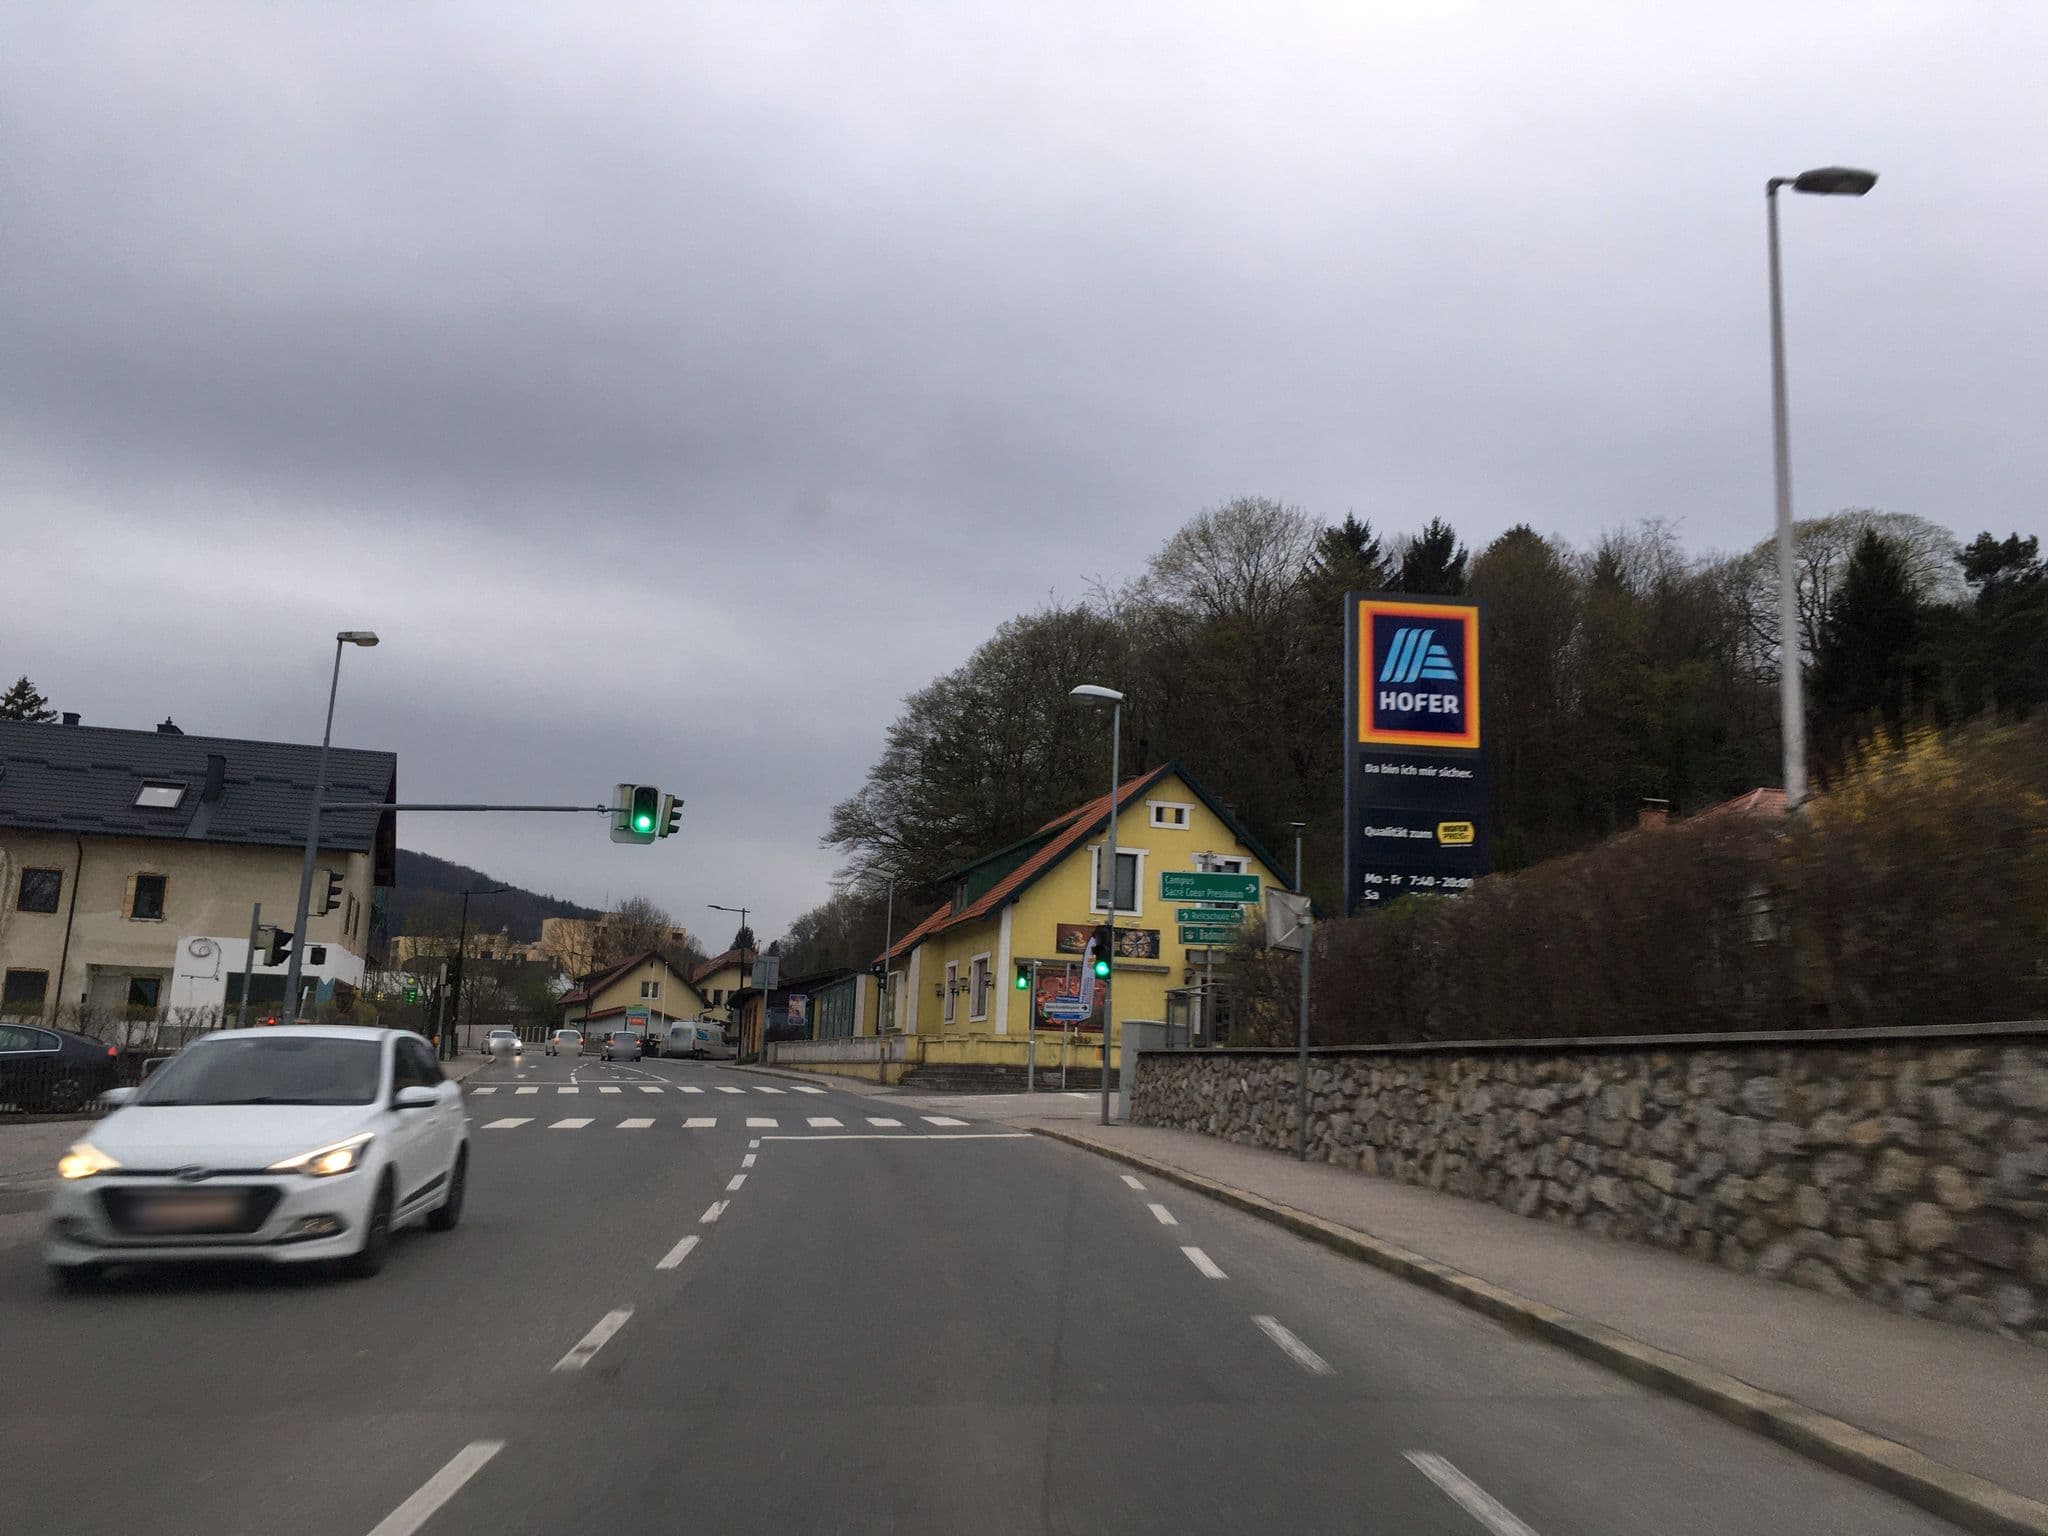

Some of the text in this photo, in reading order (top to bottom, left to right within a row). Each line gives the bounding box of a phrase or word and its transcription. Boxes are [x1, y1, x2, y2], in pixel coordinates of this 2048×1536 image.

[1380, 691, 1459, 714] HOFER
[1364, 763, 1380, 773] Da
[1381, 763, 1399, 775] bin
[1400, 764, 1417, 775] ich
[1418, 765, 1438, 776] mir
[1364, 826, 1432, 839] Qualität zum
[1164, 875, 1195, 885] Campus
[1364, 889, 1380, 900] Sa
